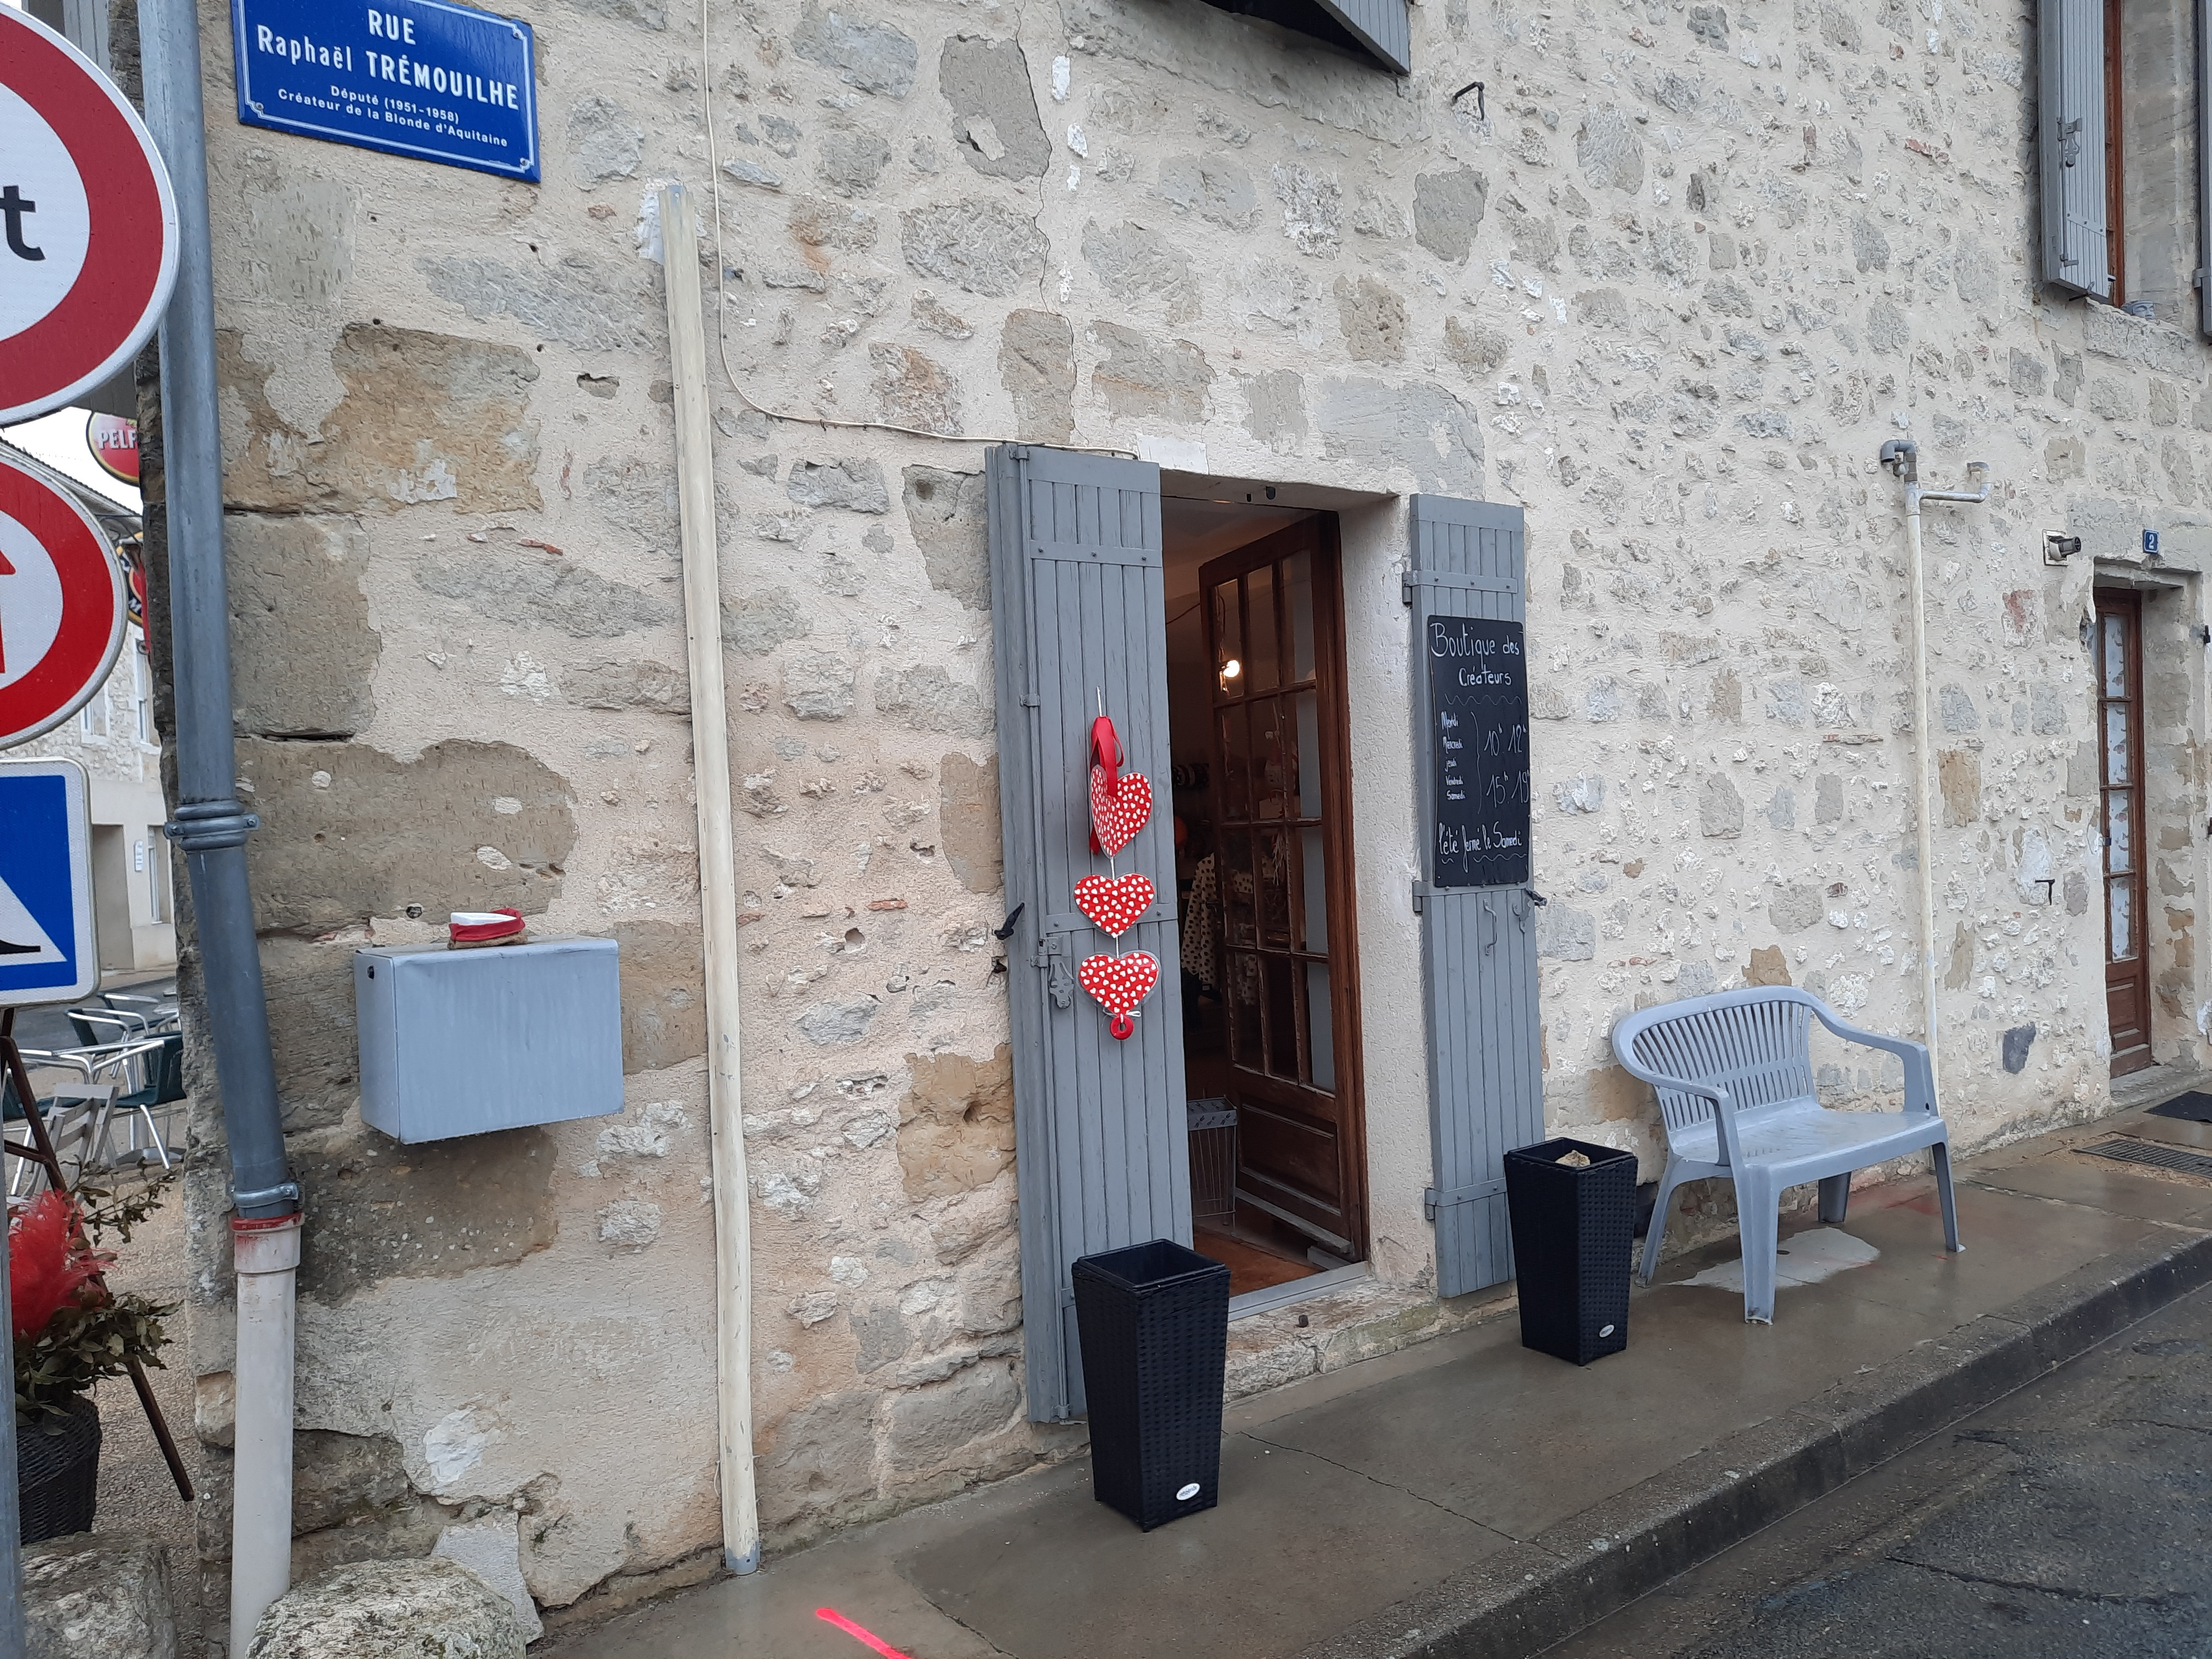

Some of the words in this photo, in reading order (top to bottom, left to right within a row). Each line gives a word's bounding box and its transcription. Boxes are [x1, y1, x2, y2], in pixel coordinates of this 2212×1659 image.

[368, 8, 416, 45] RUE
[257, 23, 352, 72] Raphaël
[365, 50, 519, 111] TRÉMOUILHE
[278, 87, 341, 111] Créateur
[346, 103, 362, 117] de
[367, 107, 380, 120] la
[385, 111, 431, 131] Blonde
[435, 122, 508, 147] d'Aquitaine
[330, 84, 379, 106] Député
[384, 97, 460, 125] (1951-1958)
[0, 185, 46, 261] t
[2148, 534, 2154, 550] 2
[1430, 622, 1495, 670] Boutique
[1503, 635, 1520, 655] des
[1458, 664, 1512, 687] Créateurs
[1439, 822, 1459, 855] l'été
[1481, 824, 1492, 851] le
[1493, 821, 1523, 848] Samedi
